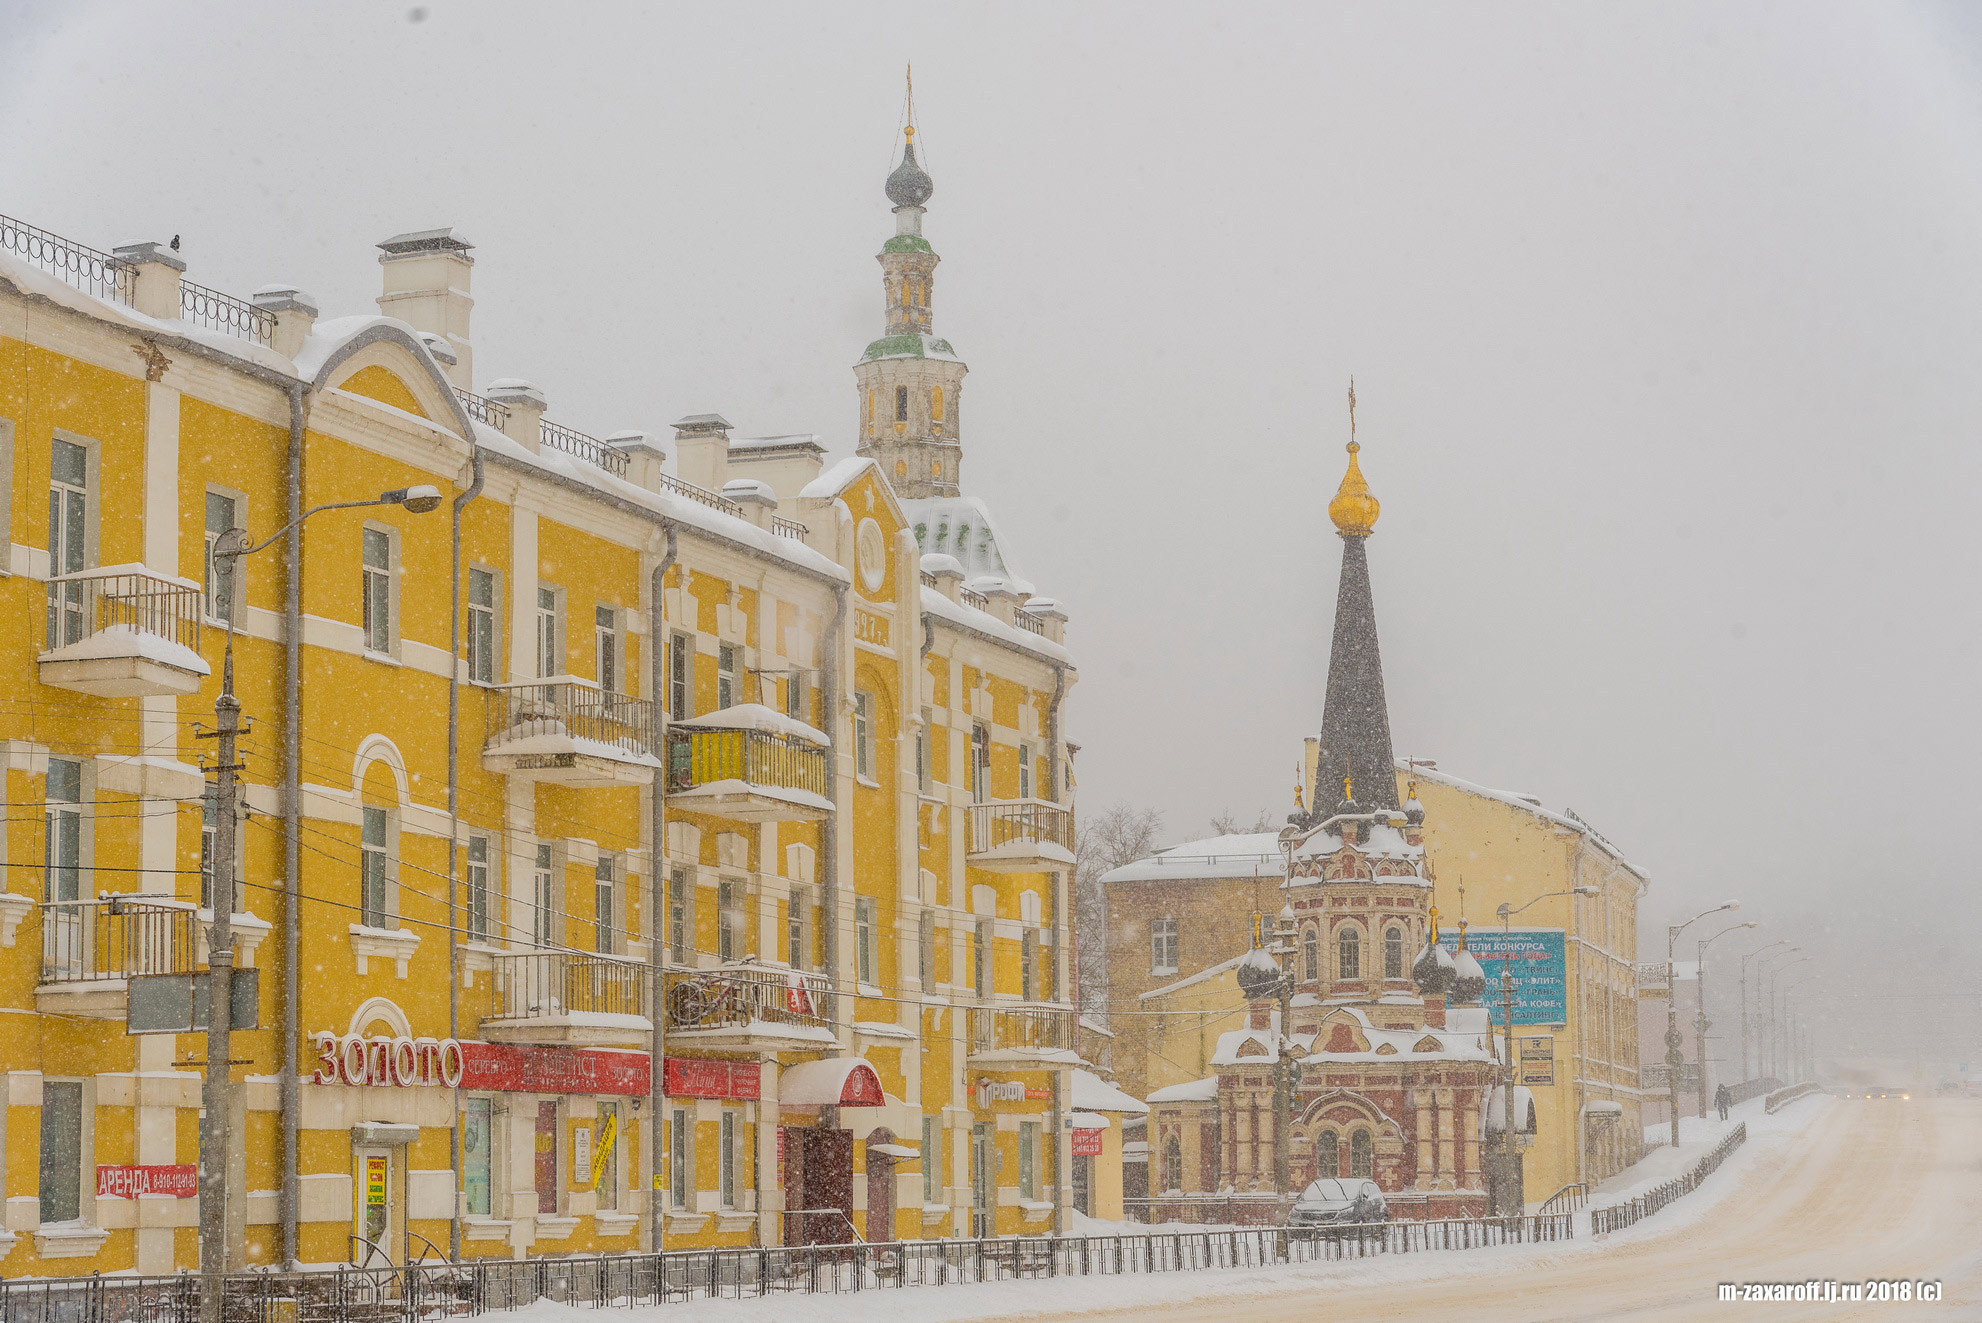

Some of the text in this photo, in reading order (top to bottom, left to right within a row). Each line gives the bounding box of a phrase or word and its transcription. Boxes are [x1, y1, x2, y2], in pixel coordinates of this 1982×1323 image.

[1442, 943, 1545, 952] БЕДТЕЛИ КОНКУРСА
[314, 1034, 463, 1088] ЗОЛОТО
[98, 1169, 151, 1200] АРЕНДА
